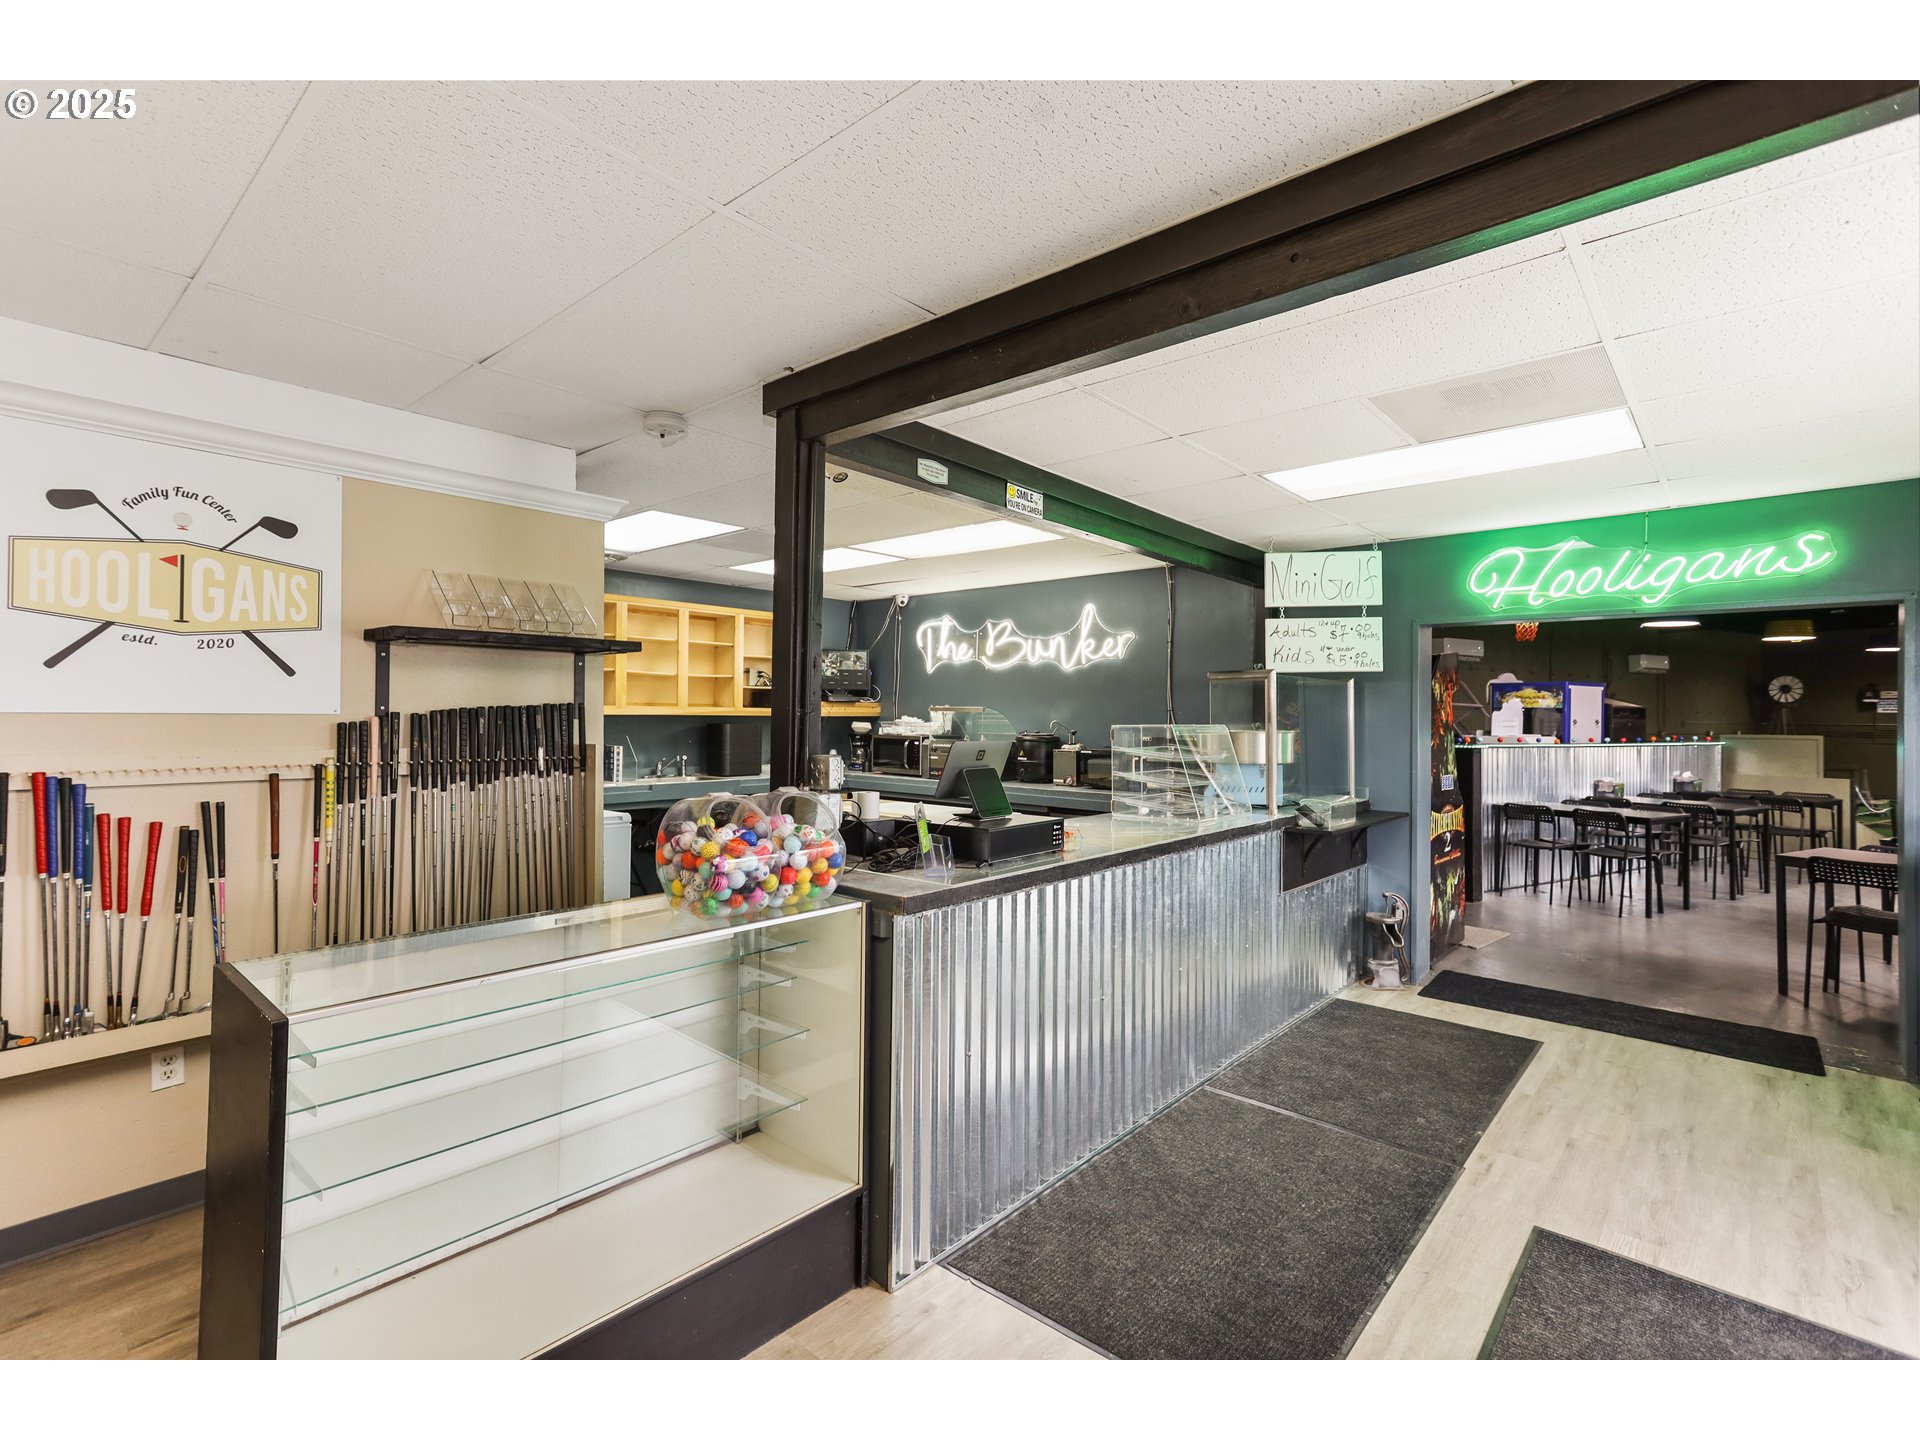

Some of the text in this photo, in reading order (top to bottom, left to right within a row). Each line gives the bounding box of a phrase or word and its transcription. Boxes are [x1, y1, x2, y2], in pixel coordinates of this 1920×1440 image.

[121, 486, 238, 524] Family Fun Center
[1016, 488, 1034, 504] SMILE
[1027, 504, 1042, 517] CAMERA
[1469, 532, 1834, 608] Hooligans
[916, 602, 1137, 673] The Bunker
[1269, 622, 1318, 640] Adults
[121, 633, 235, 650] estd. 2020
[1272, 644, 1316, 665] Kids
